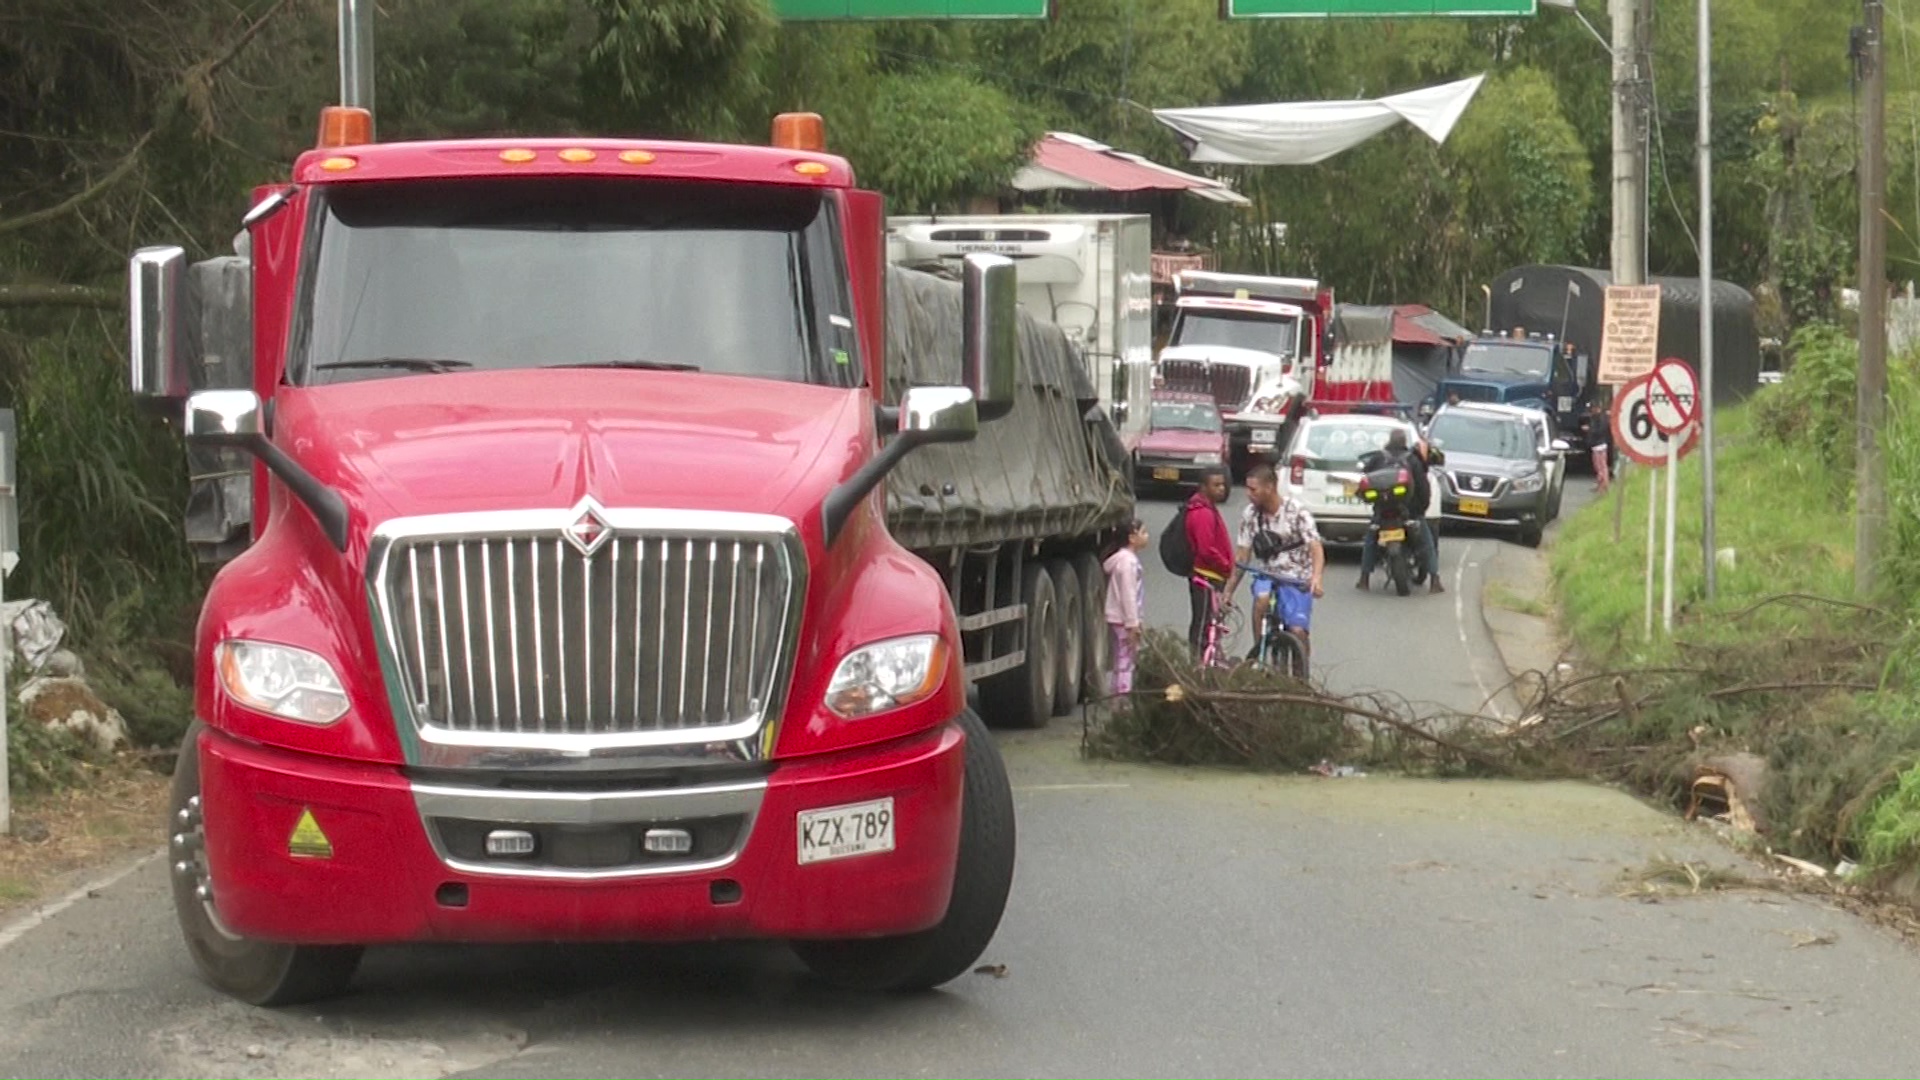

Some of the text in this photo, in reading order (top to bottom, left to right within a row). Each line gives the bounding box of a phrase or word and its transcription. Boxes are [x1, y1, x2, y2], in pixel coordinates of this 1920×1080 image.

[956, 243, 1022, 252] THERMO KING
[1325, 495, 1361, 505] POLI
[803, 810, 890, 850] KZX 789
